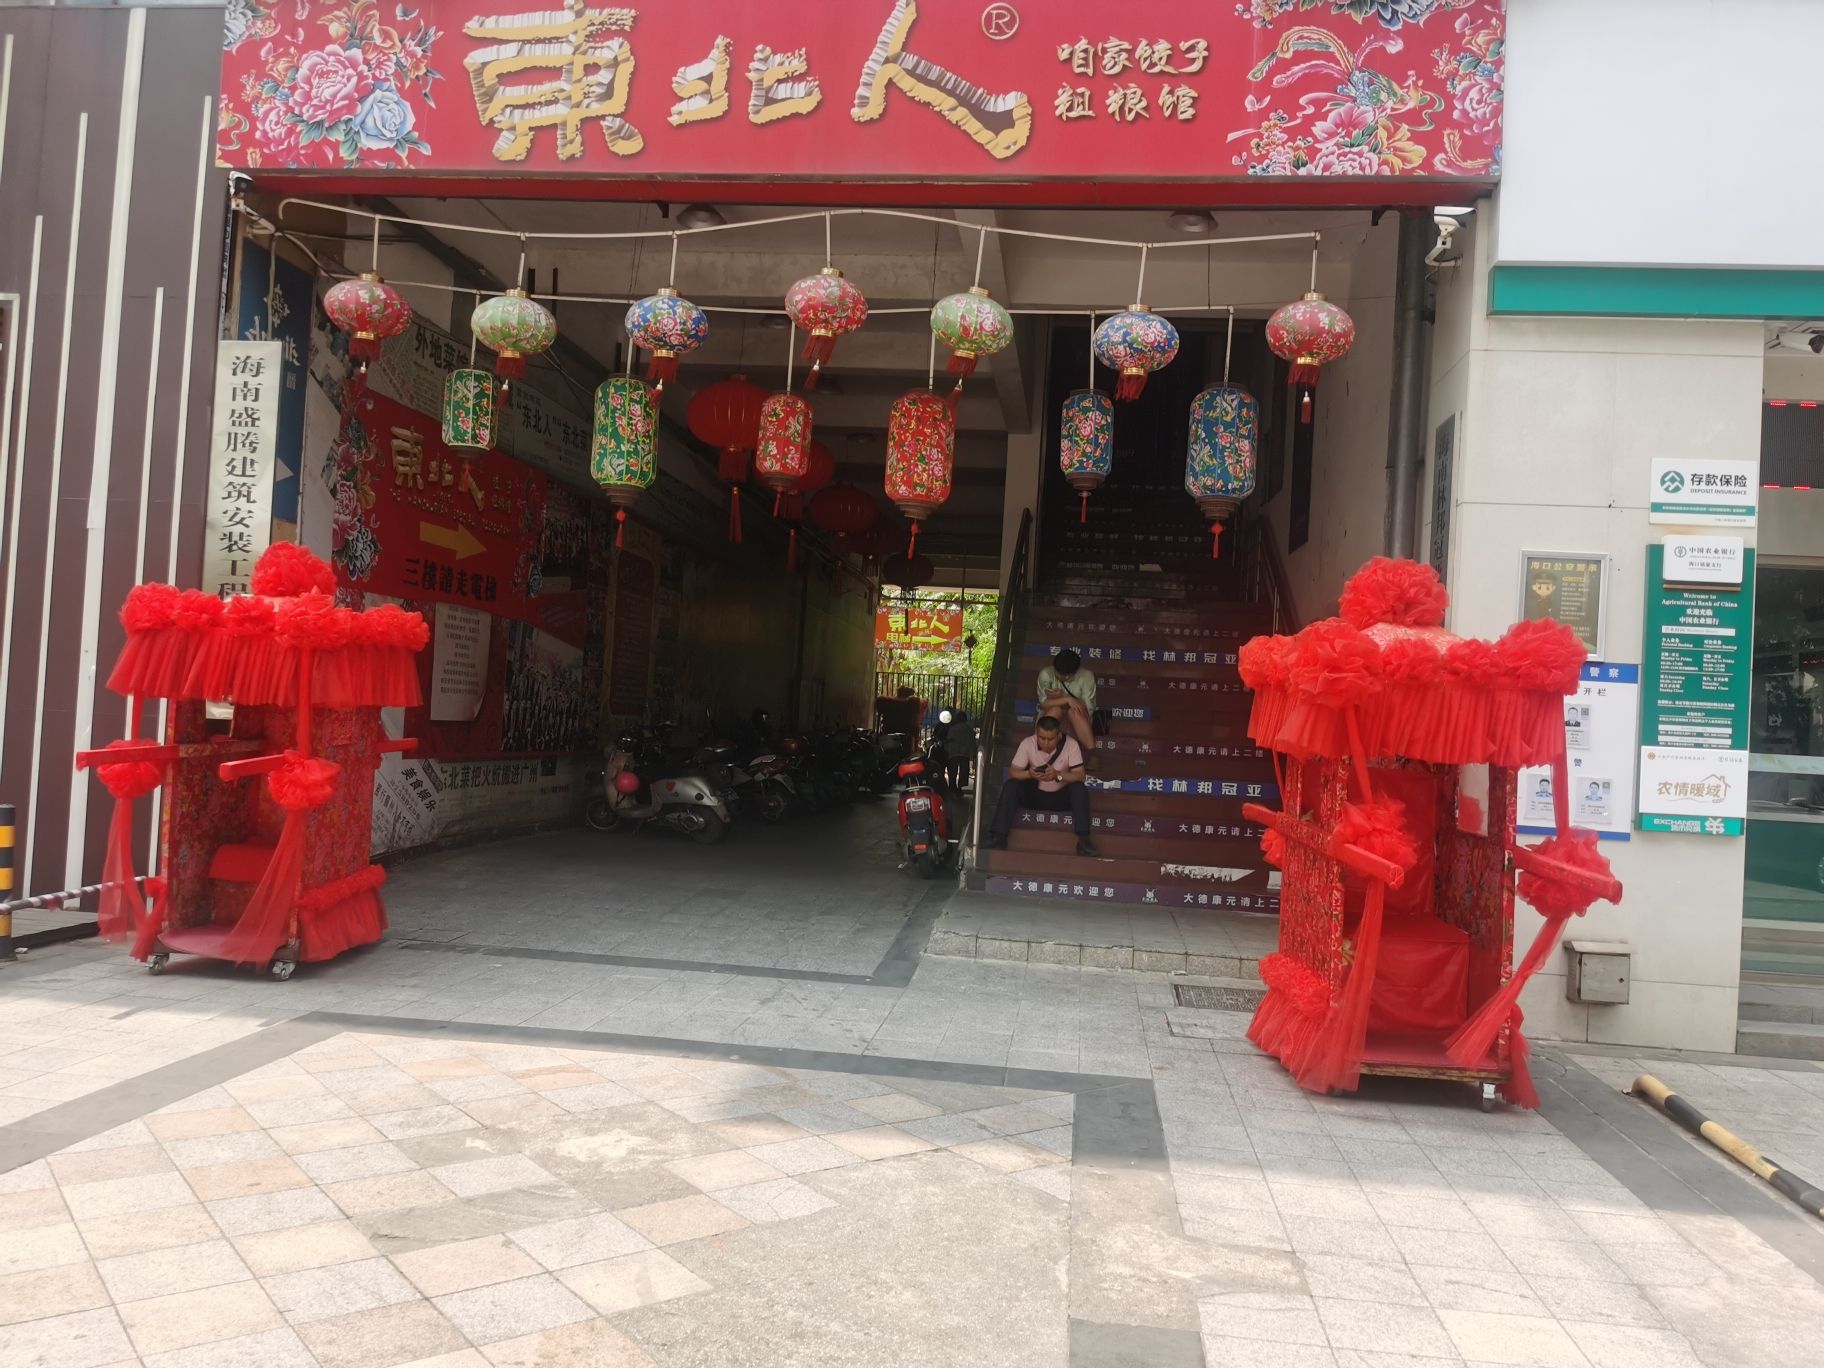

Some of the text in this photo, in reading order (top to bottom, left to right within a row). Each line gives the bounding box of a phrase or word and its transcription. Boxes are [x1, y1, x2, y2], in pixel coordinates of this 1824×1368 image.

[1057, 36, 1209, 77] 咱家饺子
[1054, 82, 1200, 122] 粗粮馆
[1690, 473, 1747, 488] 存款保险
[1714, 489, 1747, 497] INSURANCE
[1689, 547, 1736, 556] 中国农业银行
[1683, 592, 1709, 600] Welcome
[1661, 599, 1697, 608] Agricultural
[1679, 616, 1720, 625] 中国农业银行
[1143, 648, 1240, 665] 找林邦冠亚
[1589, 667, 1620, 679] 警察
[1147, 777, 1263, 798] 找林邦冠亚
[1013, 880, 1115, 898] 大德康元欢迎您
